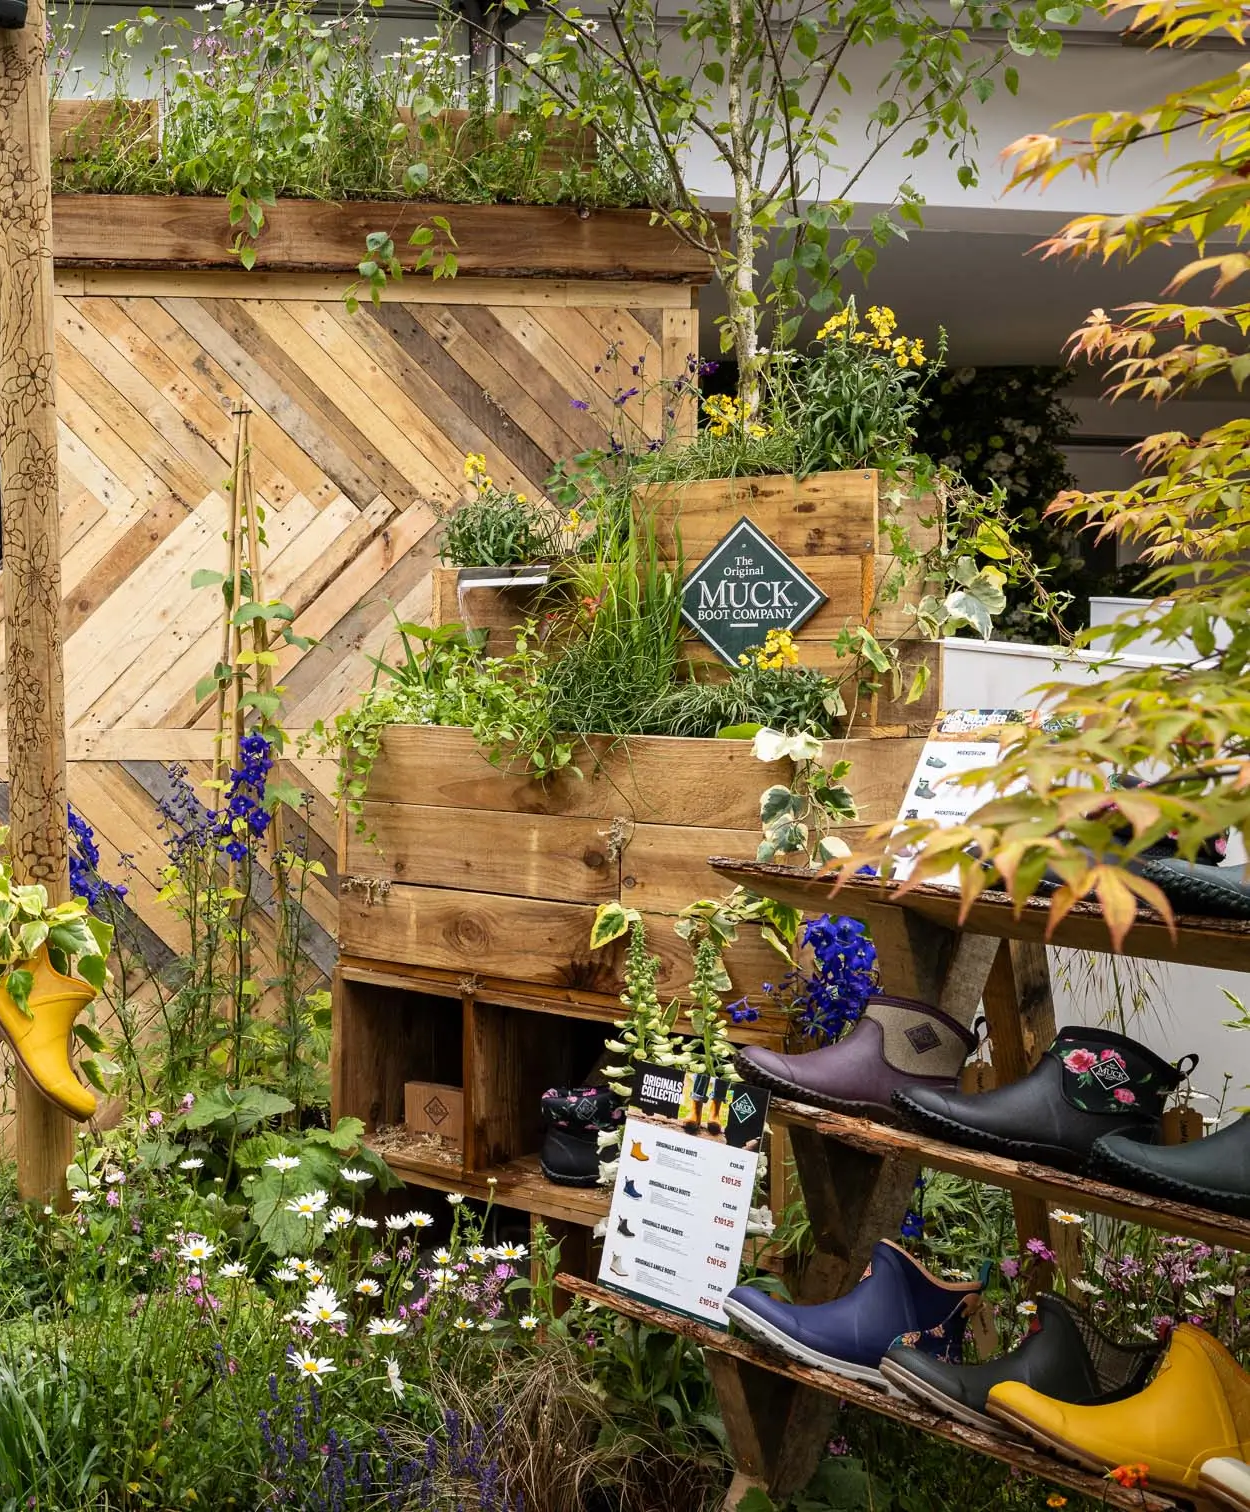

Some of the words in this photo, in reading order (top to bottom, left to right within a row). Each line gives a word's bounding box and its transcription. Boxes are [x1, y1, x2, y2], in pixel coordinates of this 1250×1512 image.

[734, 556, 754, 566] The
[723, 565, 764, 579] Original
[697, 610, 730, 621] BOOT
[732, 608, 794, 620] COMPANY
[643, 1073, 683, 1093] ORIGINALS
[721, 1175, 742, 1187] £101.25
[713, 1216, 734, 1228] £101.25
[706, 1256, 727, 1269] £101.25
[699, 1296, 720, 1310] £101.25
